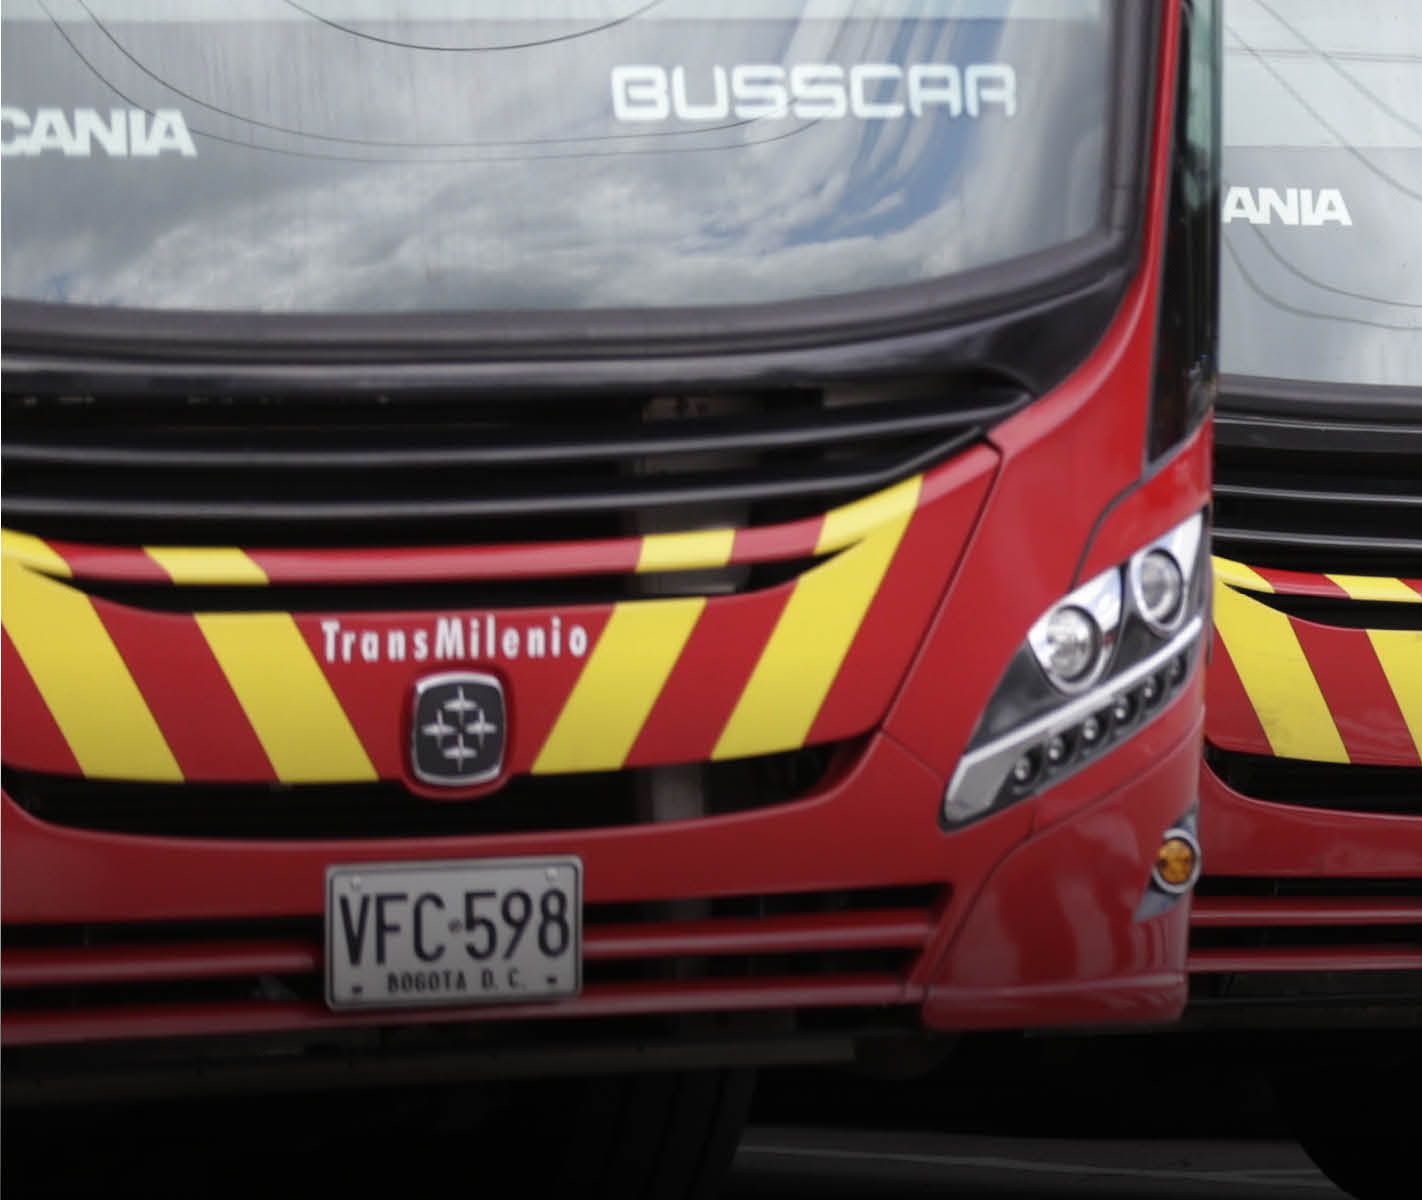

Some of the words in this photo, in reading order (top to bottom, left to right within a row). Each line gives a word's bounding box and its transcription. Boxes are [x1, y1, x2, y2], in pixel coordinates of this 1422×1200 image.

[611, 63, 1016, 121] BUSSCAR
[321, 614, 588, 663] TransMilenio
[388, 970, 467, 994] BOGOTA
